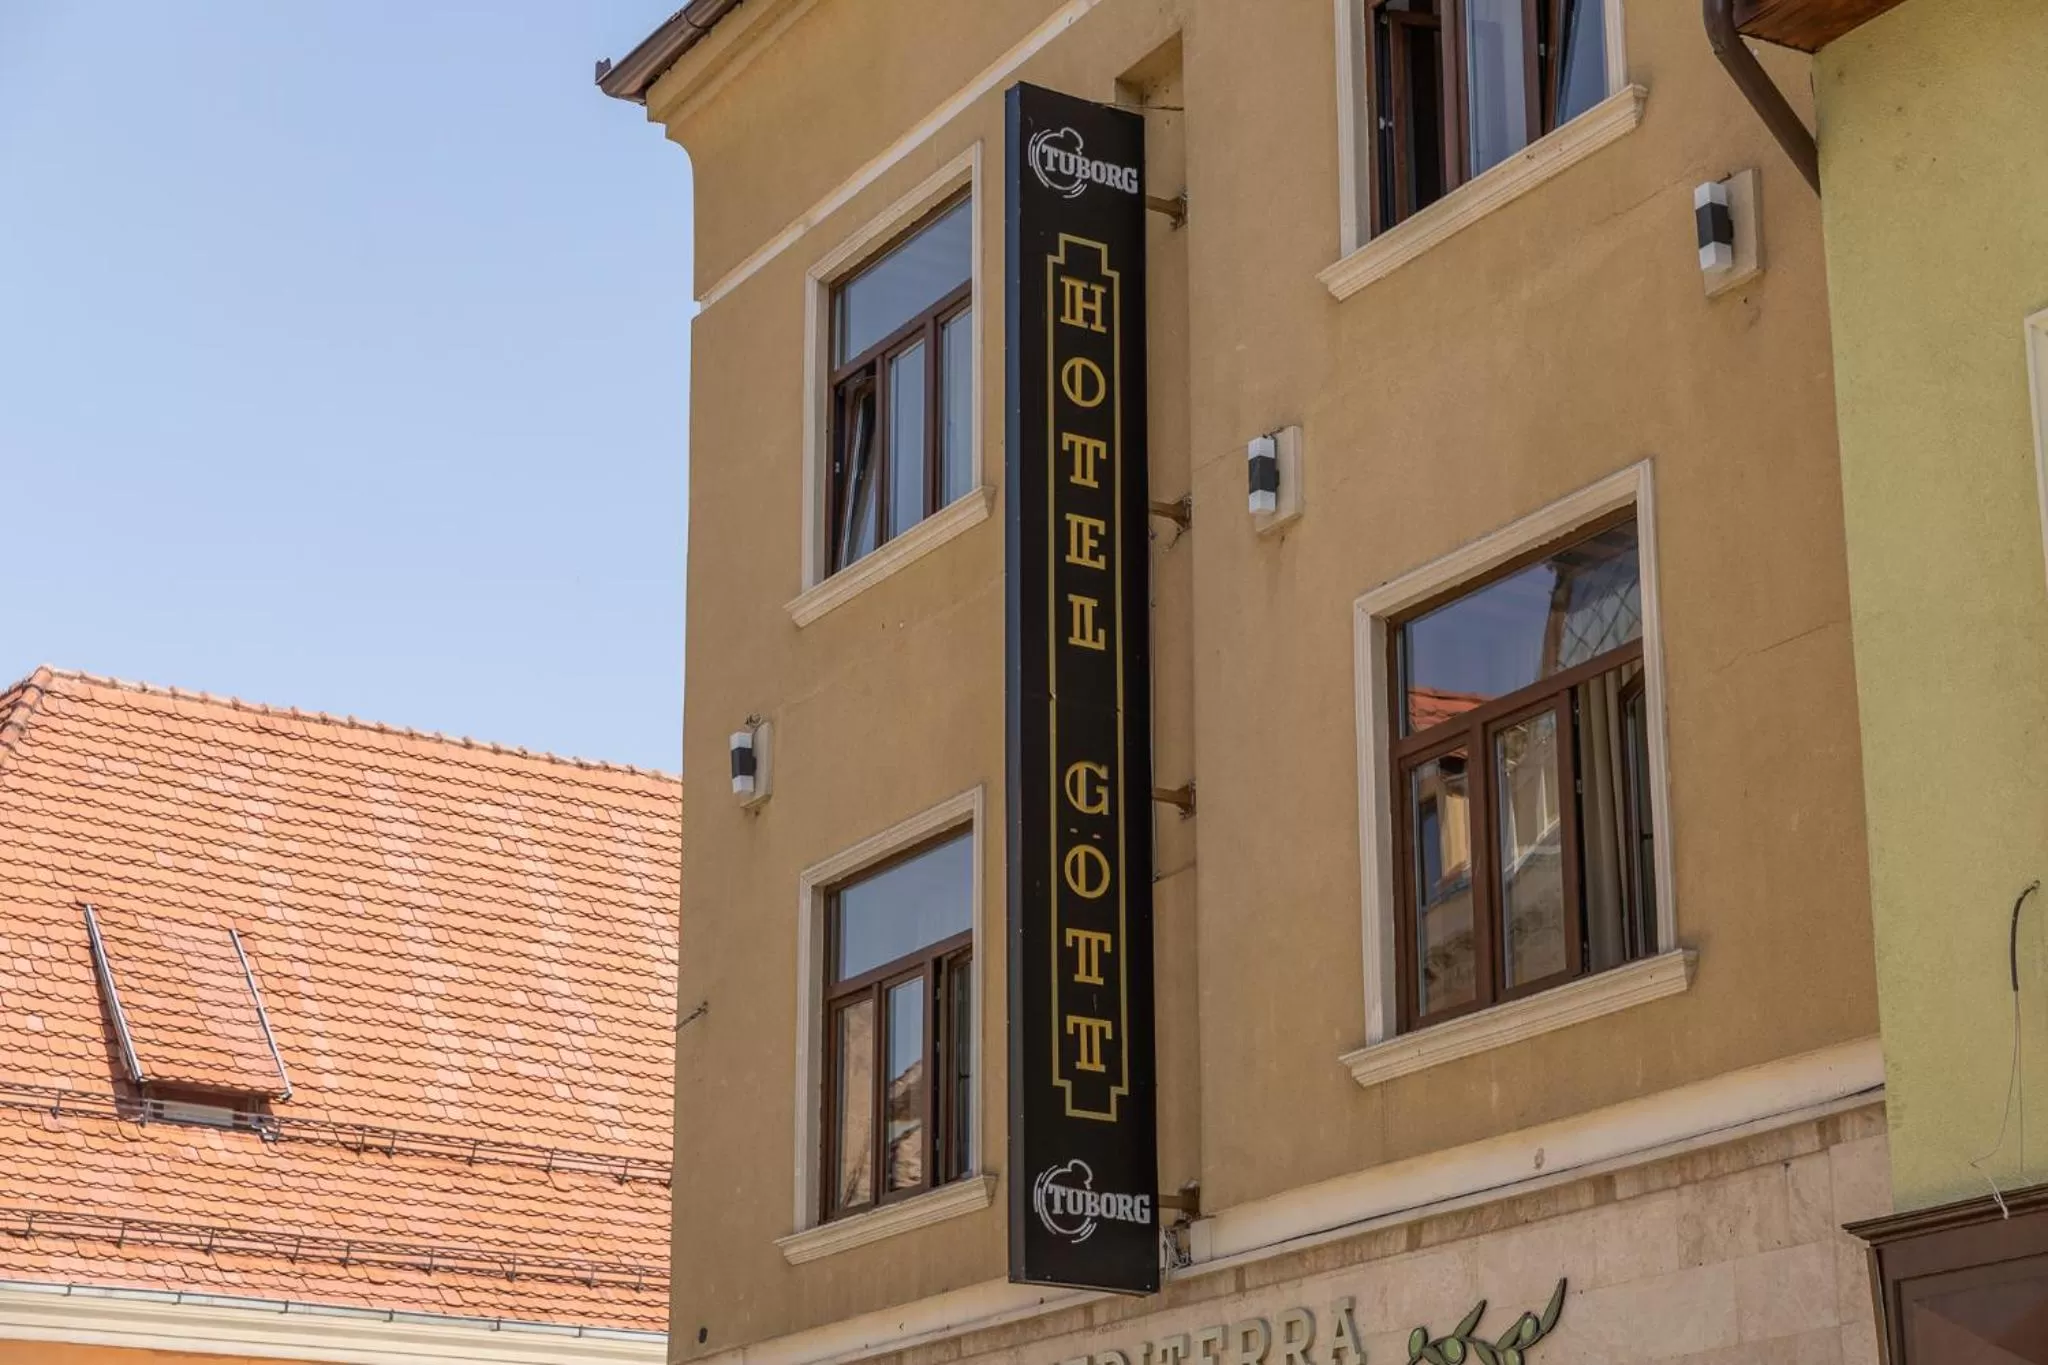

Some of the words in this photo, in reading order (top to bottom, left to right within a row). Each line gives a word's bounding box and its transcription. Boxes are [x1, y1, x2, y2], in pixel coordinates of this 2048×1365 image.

[1041, 144, 1139, 194] TUBORG
[1060, 274, 1107, 651] HOTEL
[1064, 760, 1113, 1073] GÖTT
[1048, 1183, 1151, 1224] TUBORG
